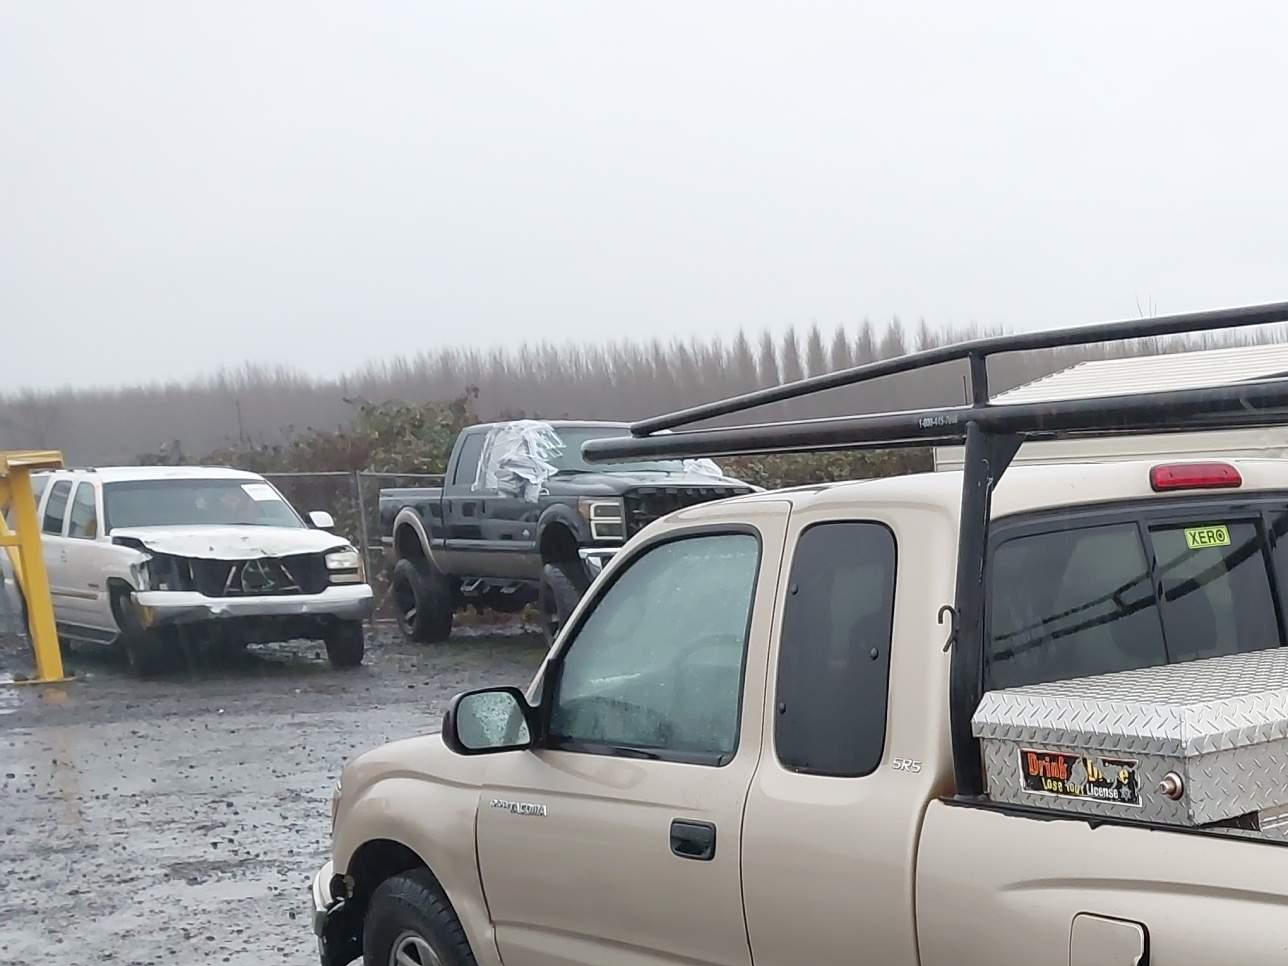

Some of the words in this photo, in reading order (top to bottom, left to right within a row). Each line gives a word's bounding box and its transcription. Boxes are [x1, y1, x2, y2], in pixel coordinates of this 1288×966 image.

[1188, 529, 1226, 546] XERO
[1027, 752, 1068, 780] Drink
[1041, 777, 1064, 792] Lose
